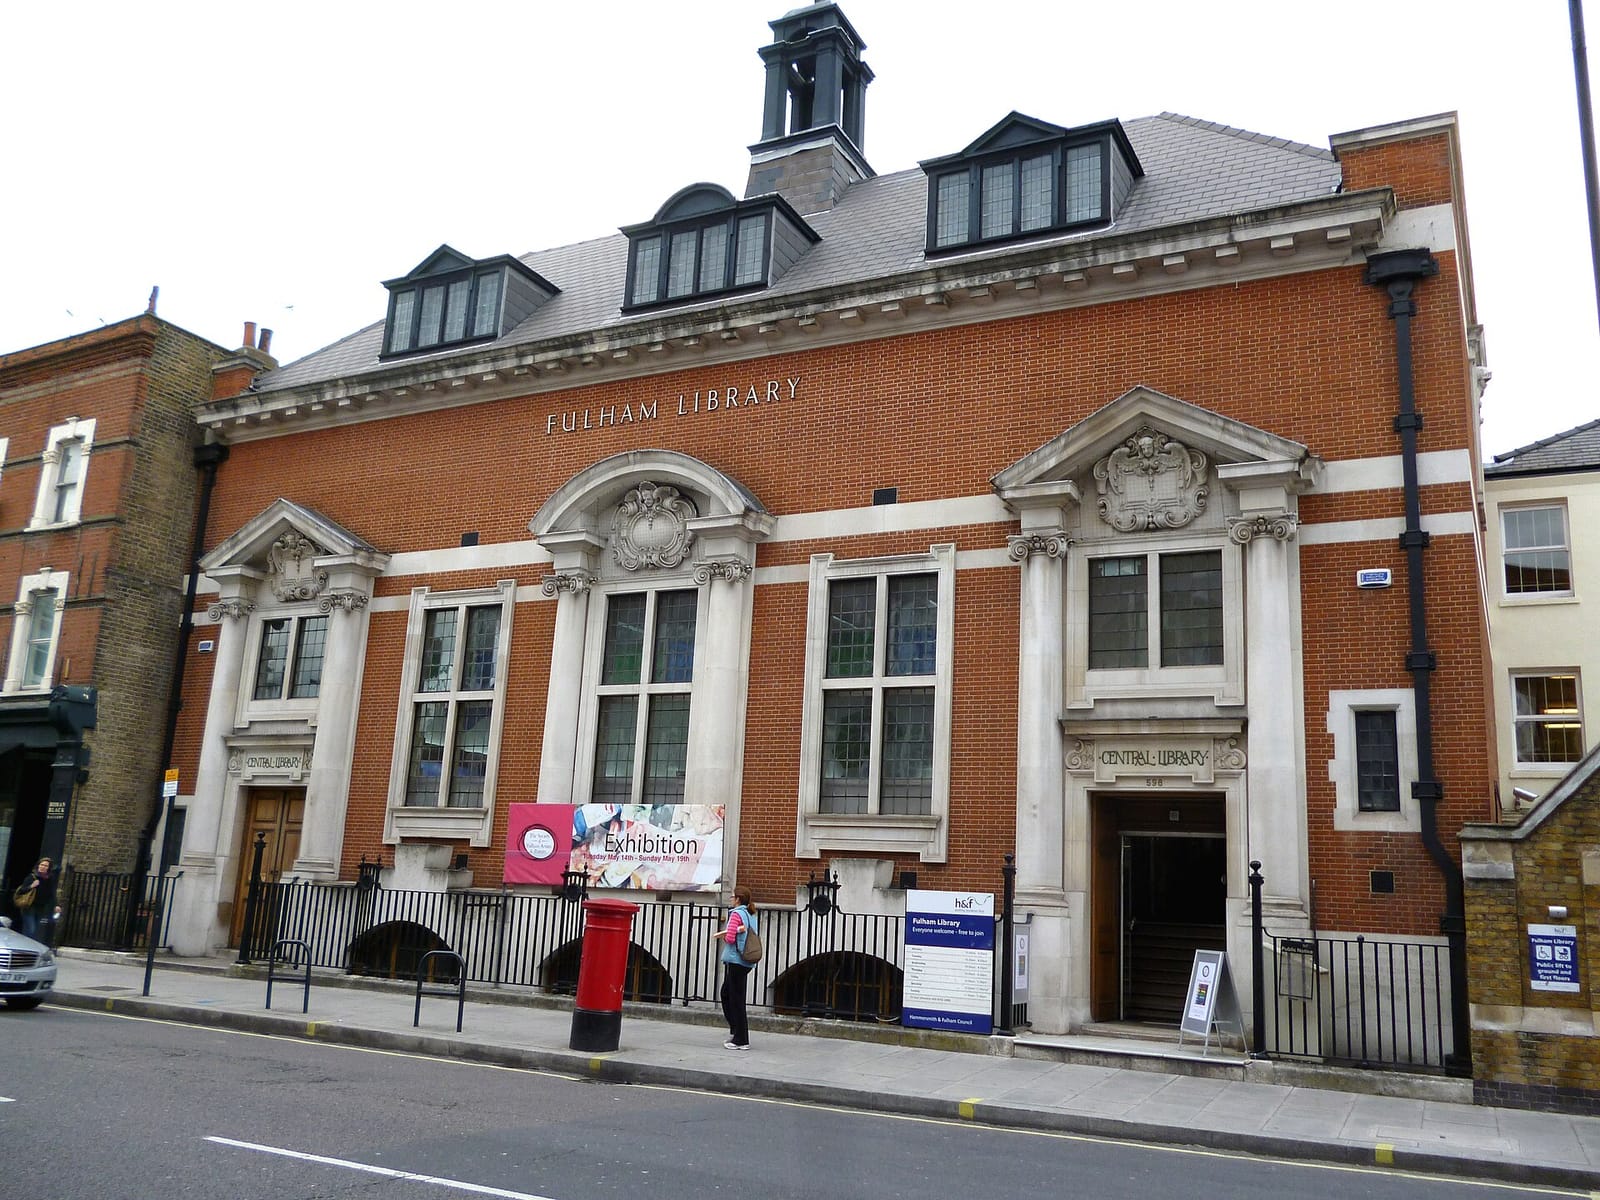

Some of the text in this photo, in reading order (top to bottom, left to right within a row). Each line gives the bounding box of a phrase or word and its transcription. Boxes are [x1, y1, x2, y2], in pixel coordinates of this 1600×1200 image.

[547, 377, 801, 434] FULHAM LIBRARY
[604, 833, 698, 854] Exhibition
[583, 853, 606, 861] Tuesday
[608, 854, 620, 862] May
[639, 854, 661, 863] Sunday
[663, 855, 675, 863] May
[955, 898, 973, 909] h&f
[912, 917, 960, 928] Fulham Library
[912, 926, 933, 935] Everyone
[934, 927, 955, 935] welcome
